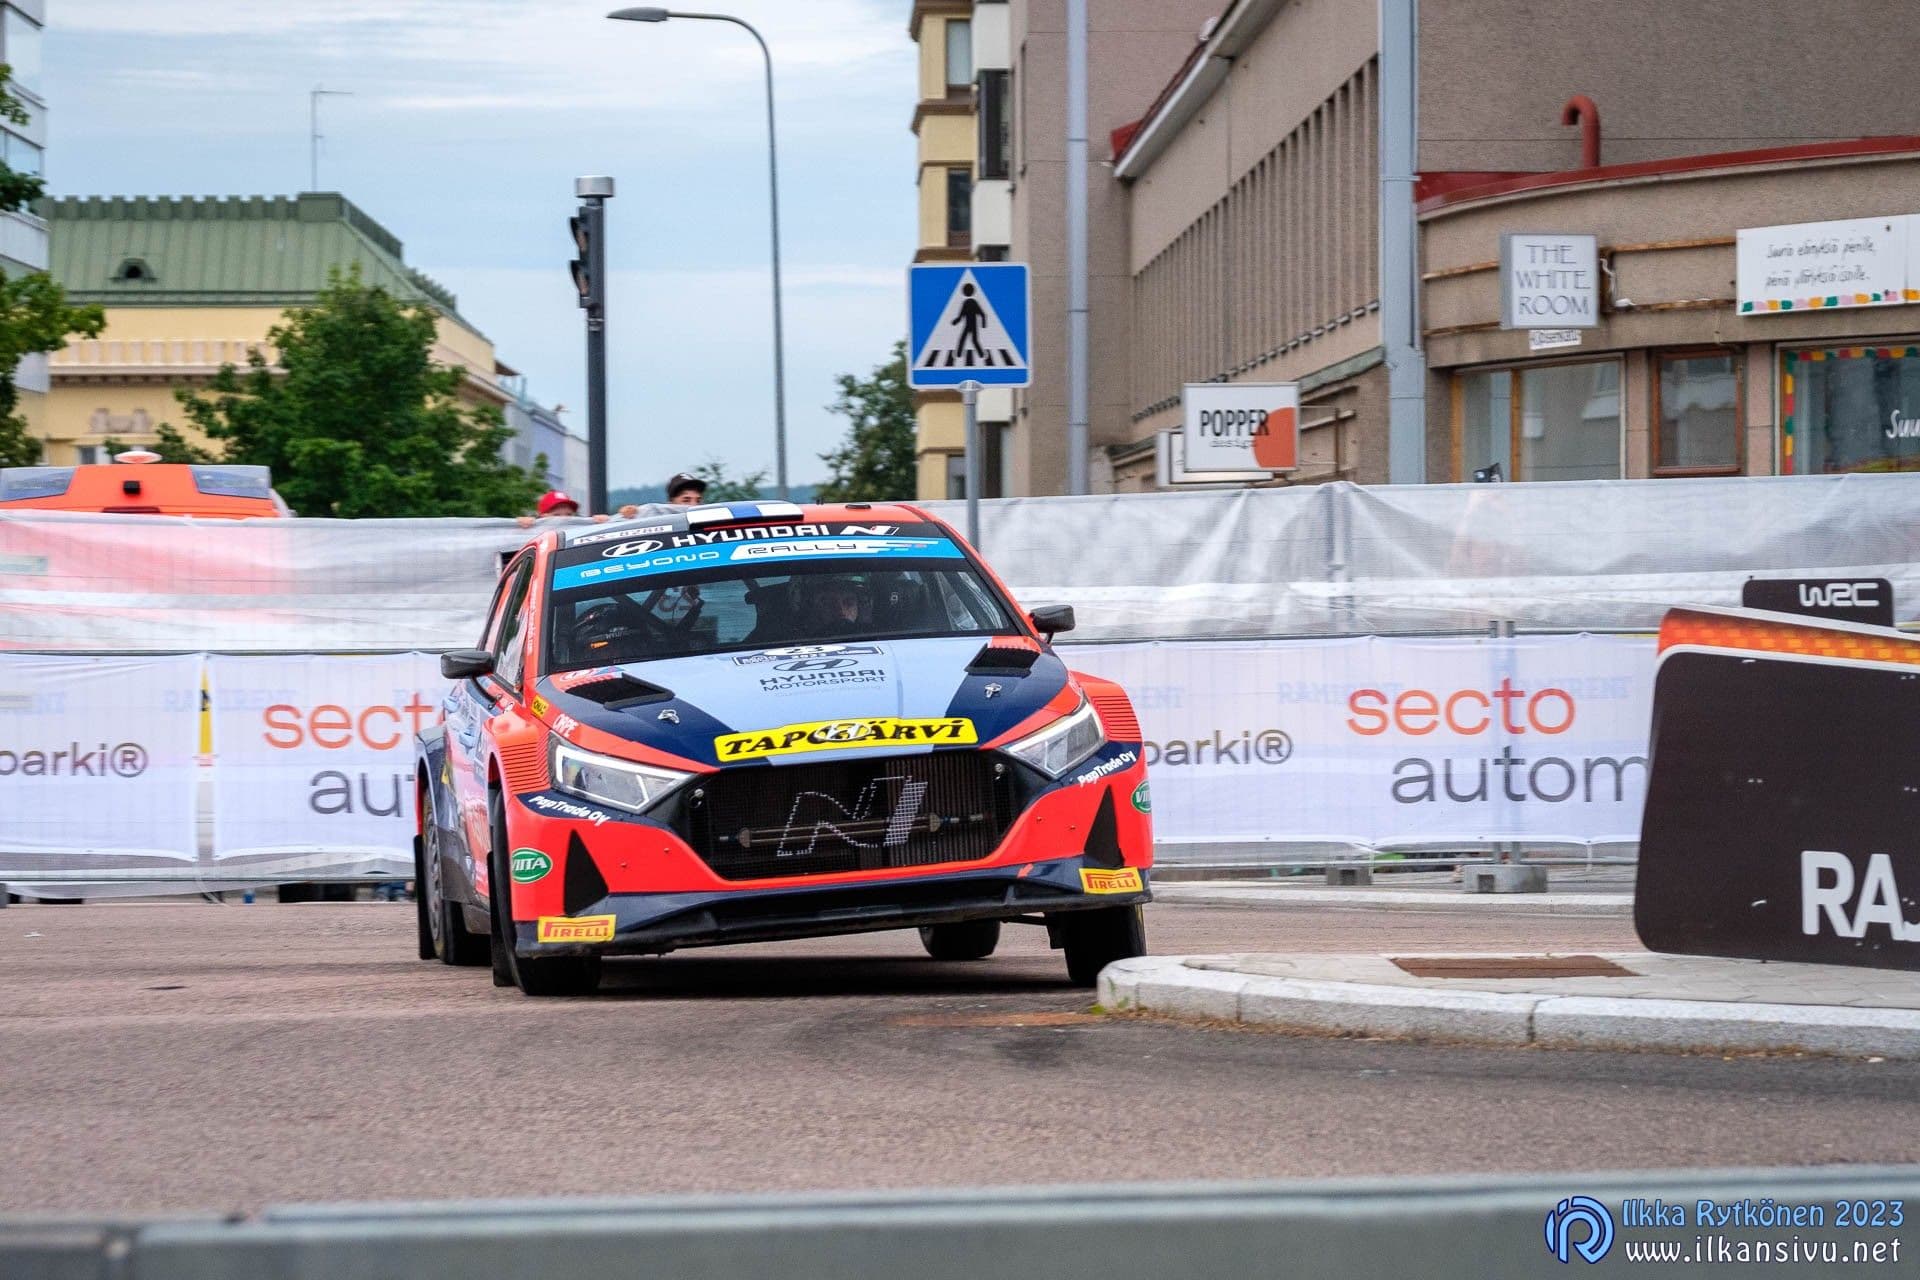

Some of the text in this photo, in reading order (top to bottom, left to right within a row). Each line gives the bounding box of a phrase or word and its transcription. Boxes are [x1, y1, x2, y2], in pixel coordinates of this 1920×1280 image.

[1524, 244, 1577, 264] THE
[1515, 269, 1592, 289] WHITE
[1518, 295, 1590, 315] ROOM
[1199, 408, 1270, 437] POPPER
[673, 524, 830, 548] HYUNDAI
[580, 543, 857, 579] BEYOND RALLY
[1799, 582, 1881, 608] WRC
[759, 669, 886, 686] HYUNDAI
[763, 676, 887, 692] MOTORSPORT
[1346, 677, 1577, 736] secto
[262, 692, 447, 751] sect
[1076, 749, 1138, 788] PapTrade Oy
[1391, 745, 1650, 804] autom
[528, 795, 612, 827] PapTrade Oy
[1084, 871, 1138, 889] PIRELLI
[543, 919, 610, 938] PIRELLI
